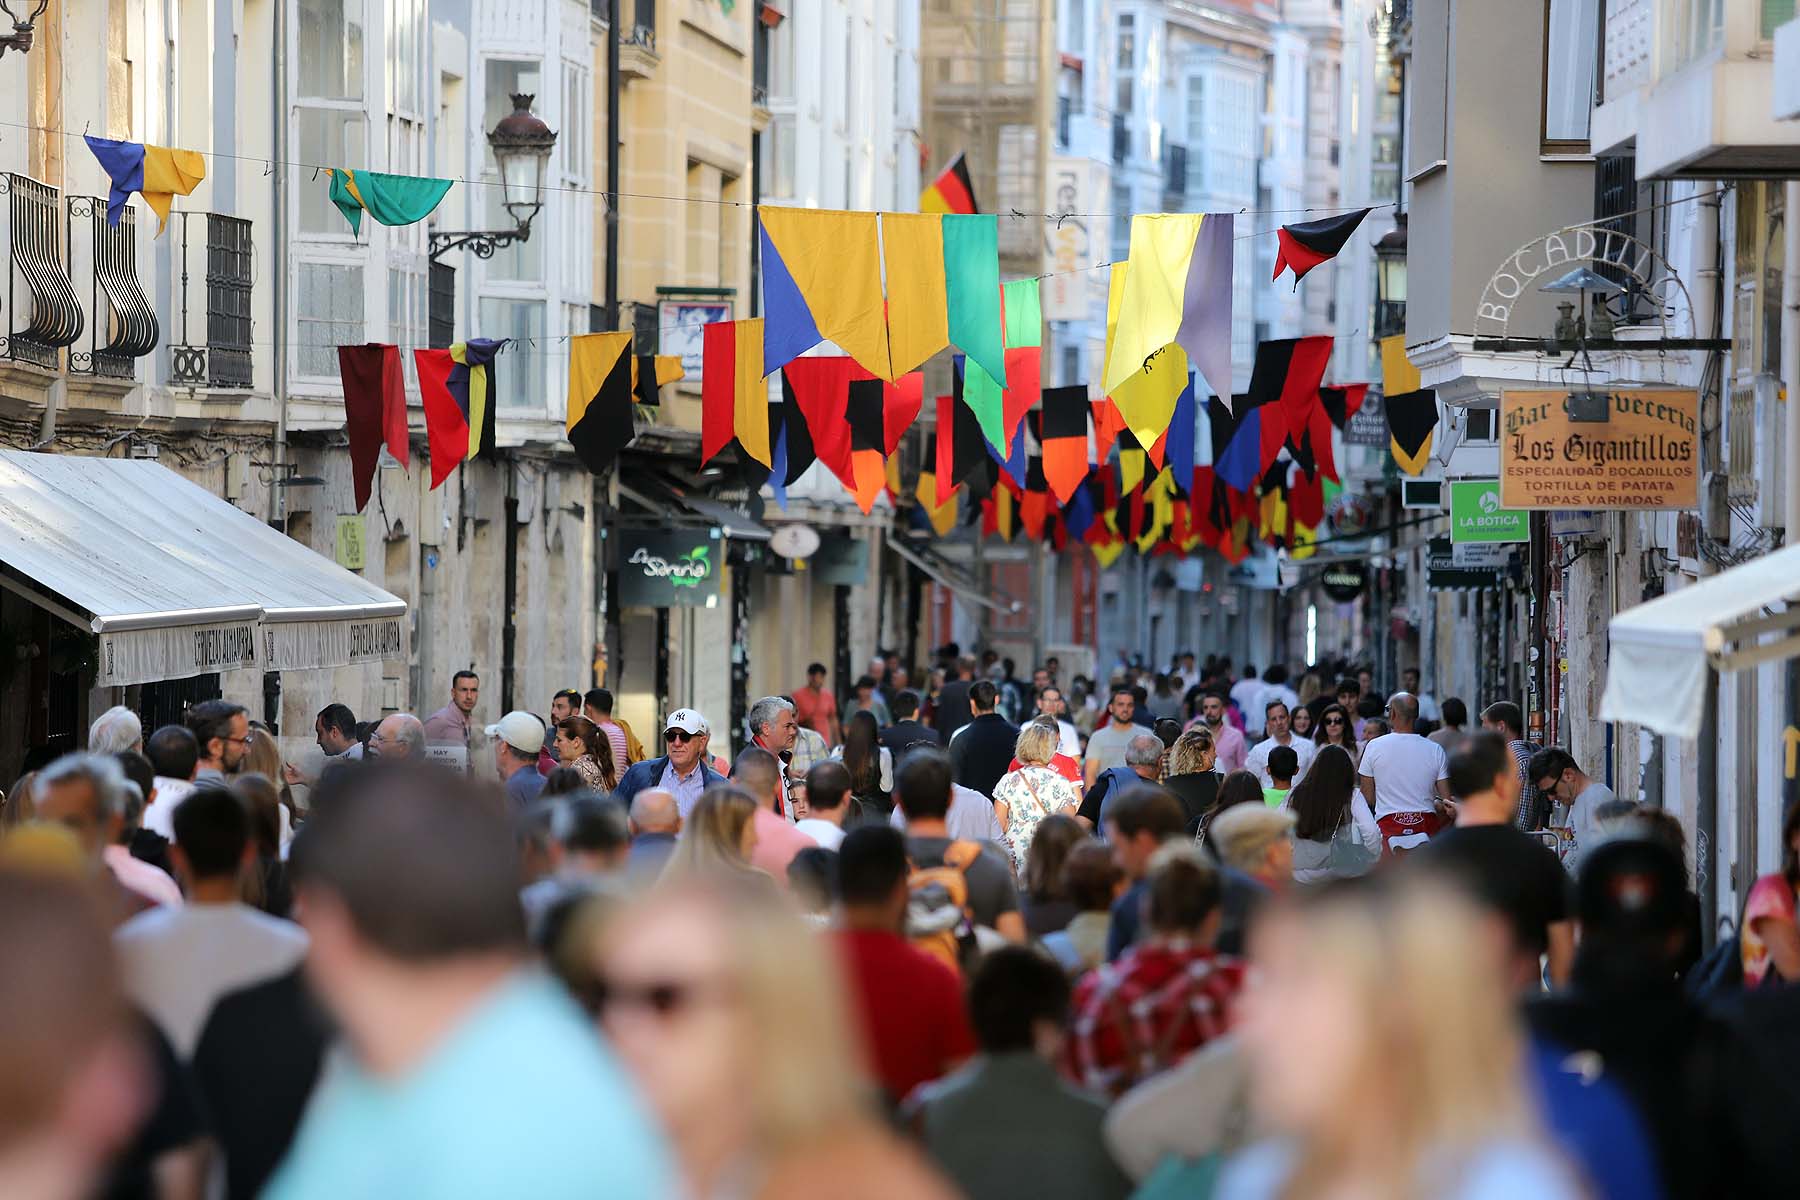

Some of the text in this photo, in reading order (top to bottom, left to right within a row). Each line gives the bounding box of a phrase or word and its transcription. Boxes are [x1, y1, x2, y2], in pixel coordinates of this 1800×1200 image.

[1506, 402, 1552, 433] Bar
[1511, 433, 1692, 467] Los Gigantillos
[1507, 466, 1693, 477] ESPECIALIDAD BOCADILLOS
[1525, 480, 1675, 491] TORTILLA DE PATATA
[1534, 494, 1665, 505] TAPAS VARIADAS
[1459, 515, 1520, 528] LA BOTICA
[194, 629, 221, 667] CERVEZAS
[222, 626, 254, 664] ALHAMBRA
